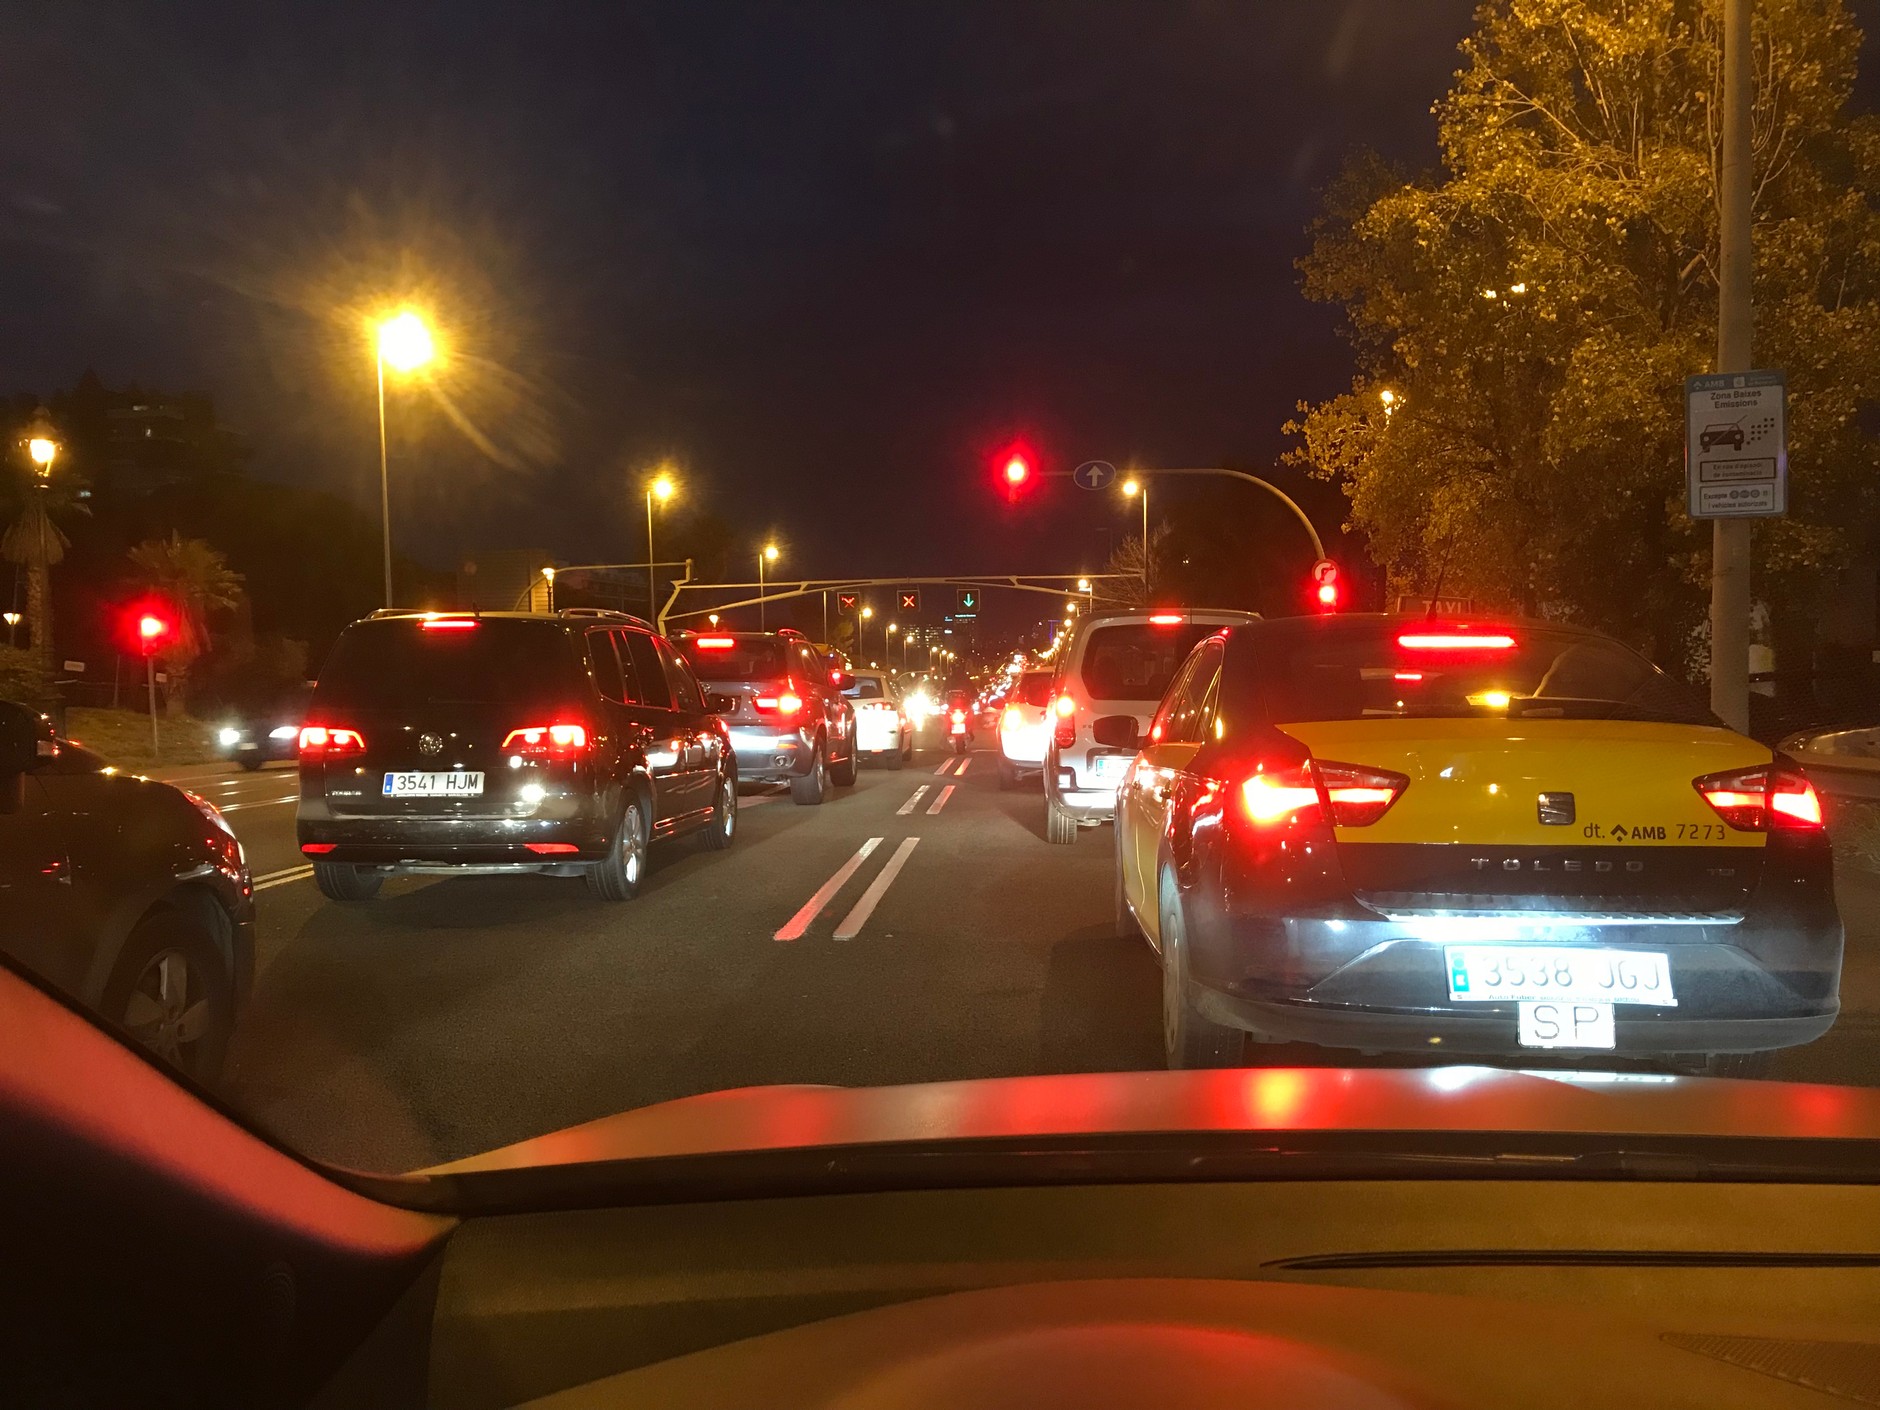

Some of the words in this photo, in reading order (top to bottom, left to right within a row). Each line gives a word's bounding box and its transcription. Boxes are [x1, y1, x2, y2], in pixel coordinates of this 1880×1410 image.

[1710, 392, 1731, 400] Zona
[1733, 390, 1762, 398] Baixes
[1714, 399, 1758, 409] Emissions
[397, 775, 435, 790] 3541
[446, 774, 479, 790] HJM
[1583, 824, 1606, 839] dt.
[1631, 826, 1667, 840] AMB
[1676, 823, 1726, 841] 7273
[1470, 857, 1644, 873] TOLEDO
[1482, 956, 1573, 987] 3538
[1598, 959, 1661, 991] JGJ
[1533, 1004, 1599, 1040] SP
